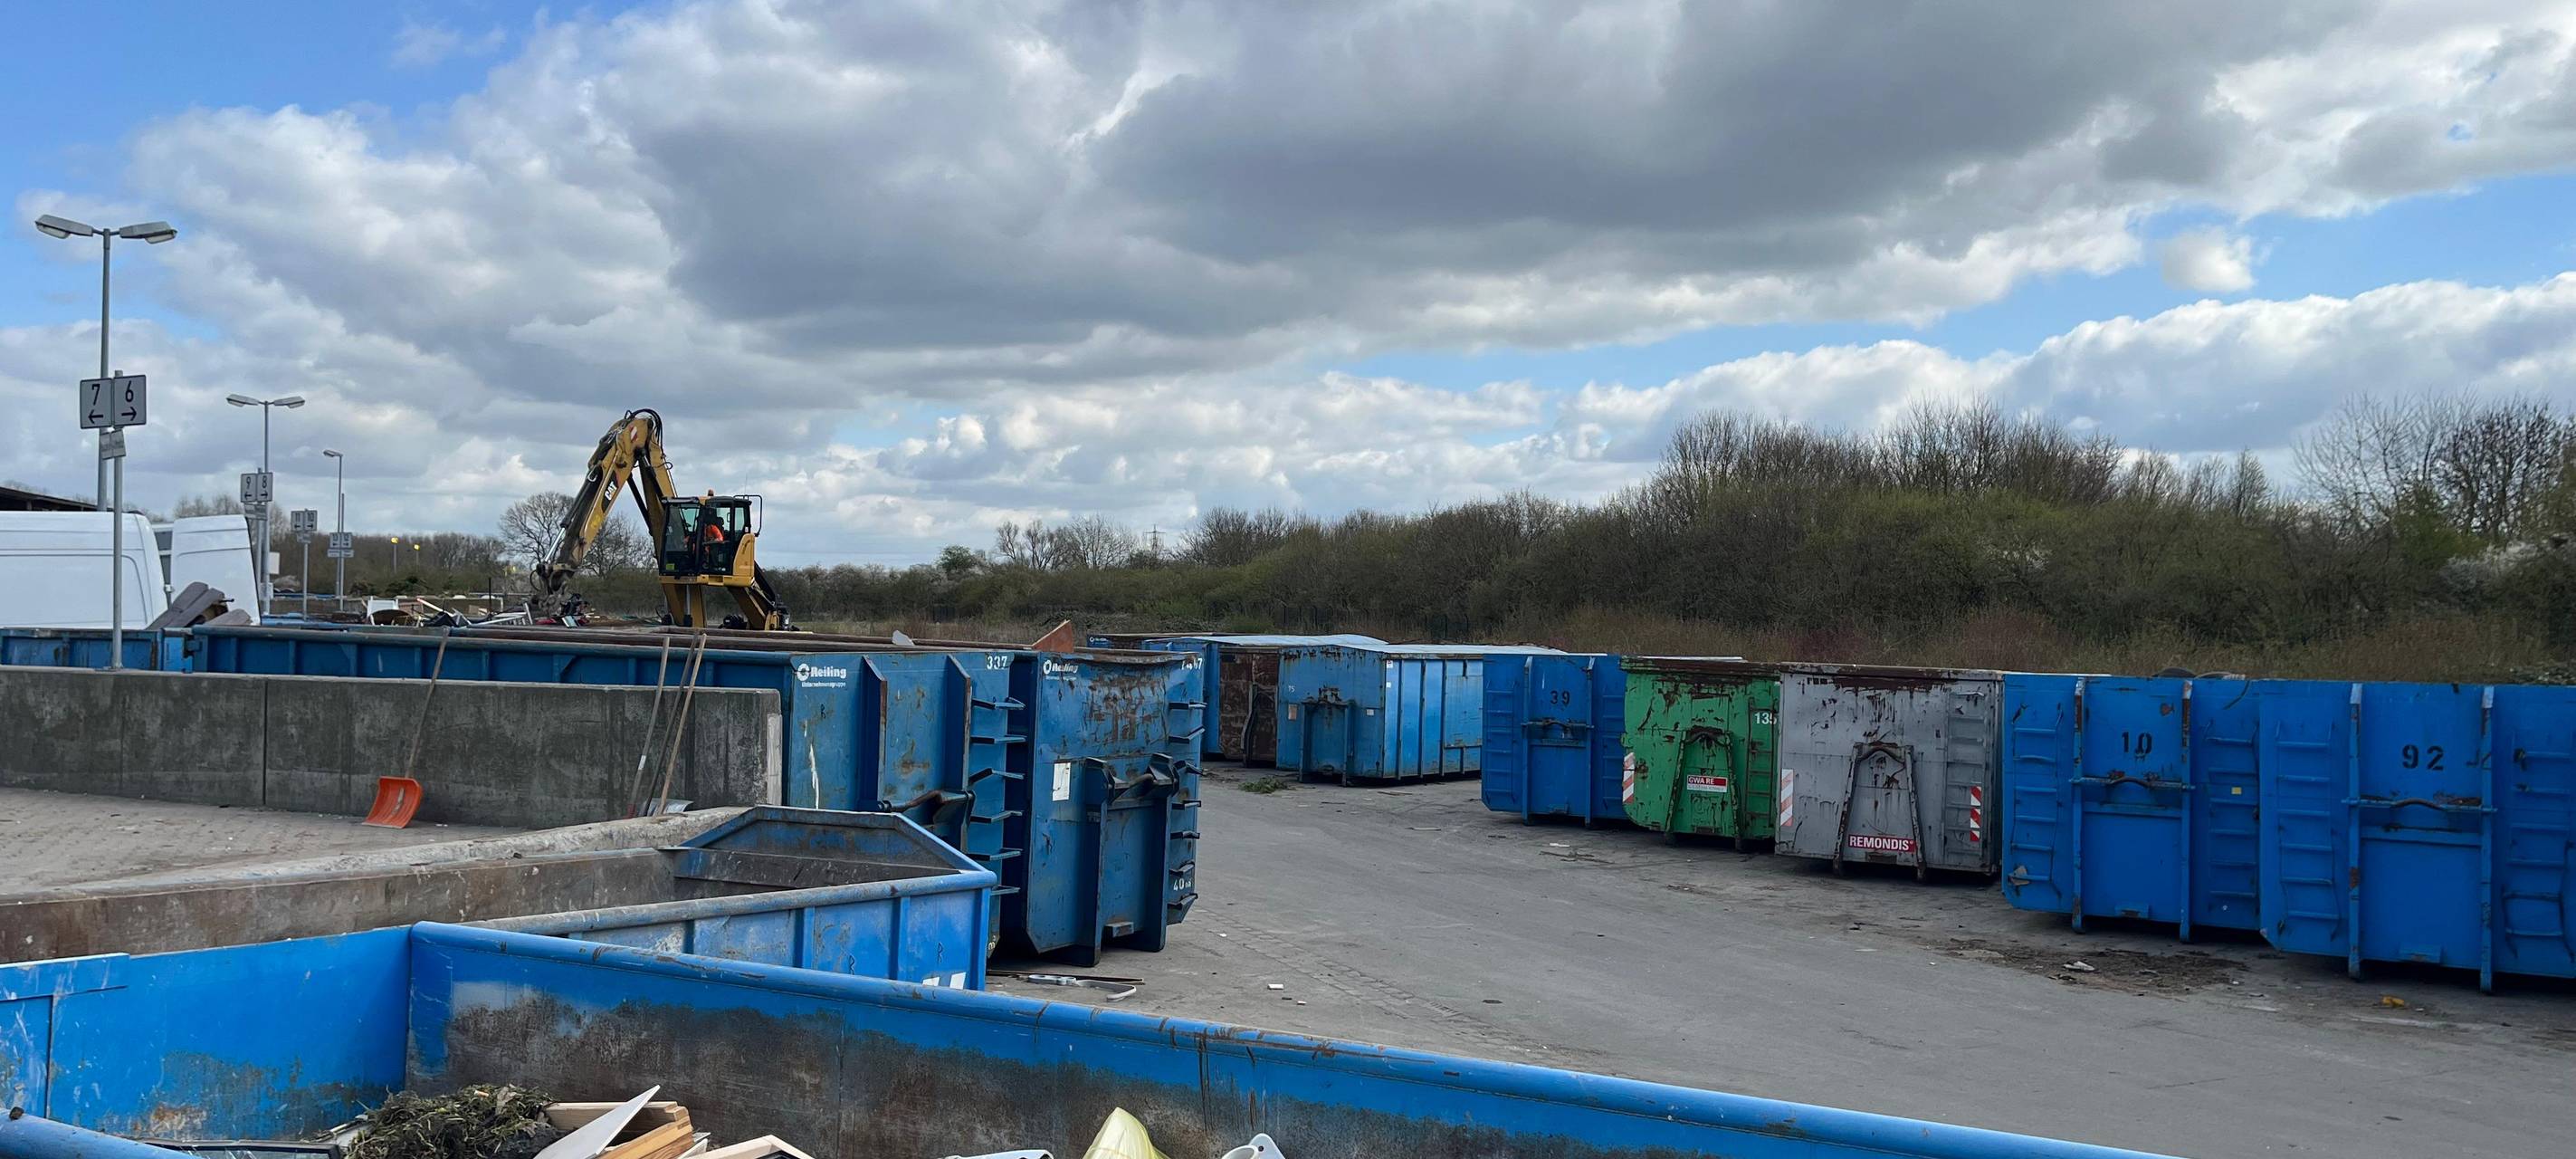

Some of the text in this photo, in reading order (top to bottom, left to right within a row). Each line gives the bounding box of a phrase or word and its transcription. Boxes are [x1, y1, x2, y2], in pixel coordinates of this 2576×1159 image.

[91, 383, 100, 406] 7
[125, 380, 134, 402] 6
[246, 476, 251, 489] 9
[262, 475, 267, 488] 8
[605, 481, 617, 501] CAT
[987, 656, 1007, 670] 337
[810, 666, 847, 679] Reiling
[1550, 690, 1570, 706] 39
[1754, 712, 1777, 724] 135
[2122, 731, 2152, 754] 10
[2402, 744, 2444, 771] 92
[1849, 836, 1909, 850] REMONDIS
[1173, 877, 1185, 891] 40
